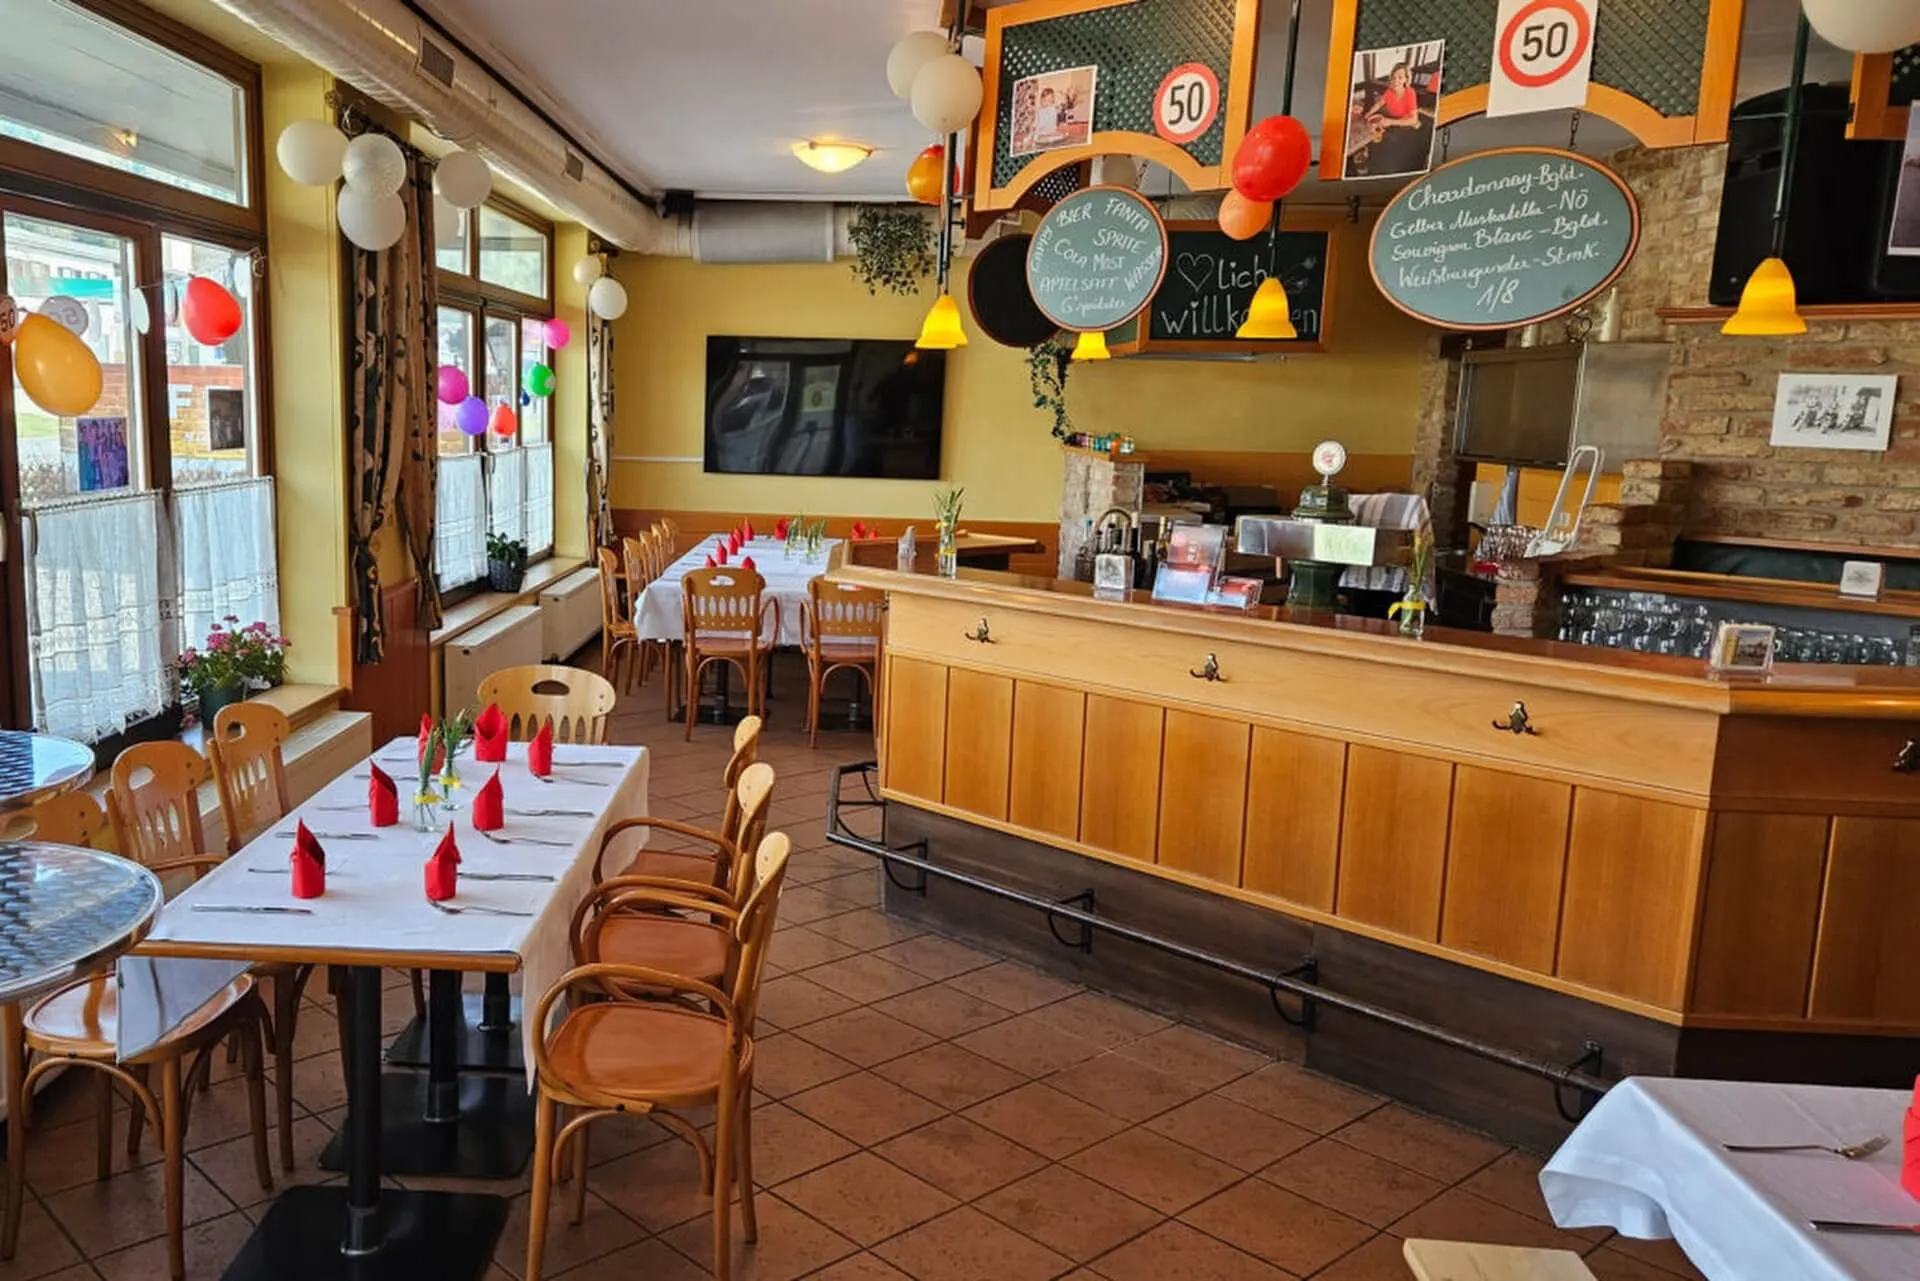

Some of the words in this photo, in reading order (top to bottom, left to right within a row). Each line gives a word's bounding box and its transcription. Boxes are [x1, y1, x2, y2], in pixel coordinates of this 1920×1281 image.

[1521, 21, 1569, 62] 50
[1167, 81, 1205, 126] 50
[1056, 202, 1093, 227] BIER
[1104, 197, 1149, 232] FANTA
[1092, 228, 1147, 254] SPRITE
[1474, 226, 1535, 249] Blanc
[1476, 276, 1520, 314] 1/8
